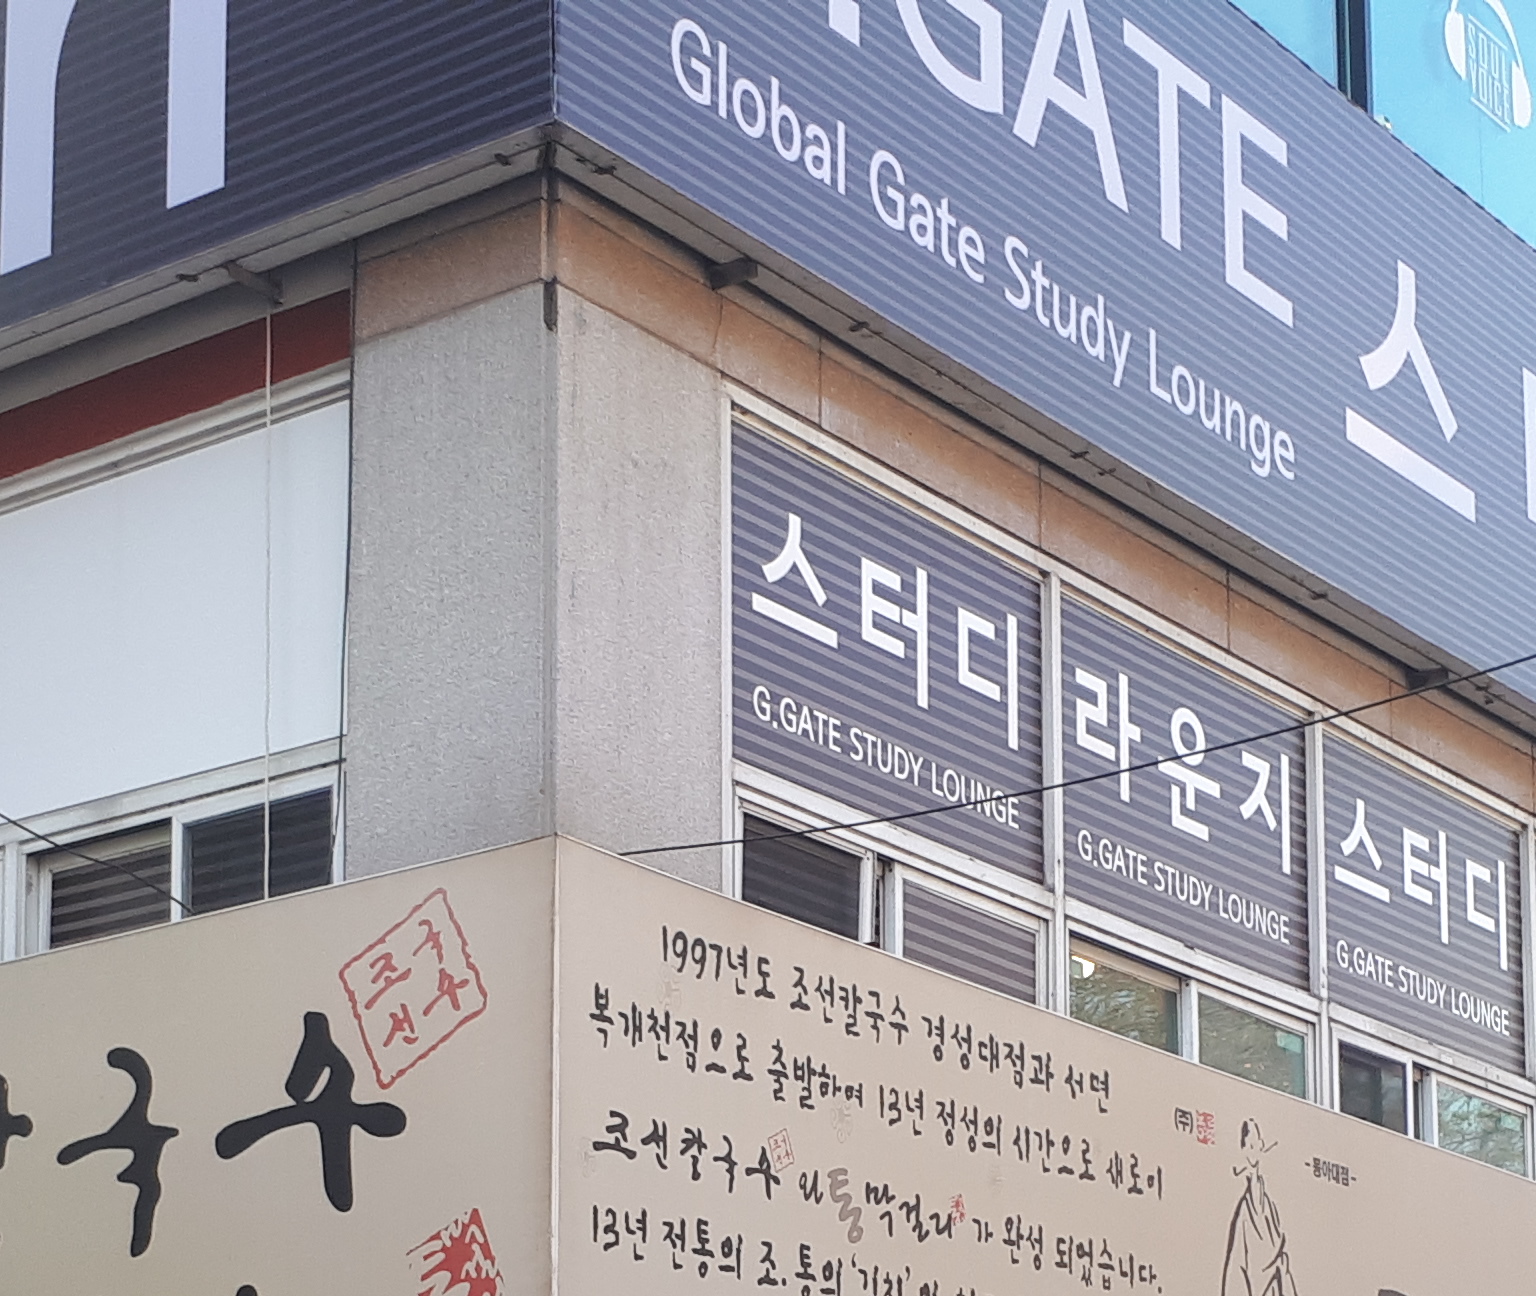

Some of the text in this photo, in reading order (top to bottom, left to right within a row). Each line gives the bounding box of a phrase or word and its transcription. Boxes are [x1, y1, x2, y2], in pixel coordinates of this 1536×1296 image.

[1467, 22, 1509, 89] SOUL
[1469, 60, 1511, 125] VOICE
[671, 17, 1298, 482] Global Gate Study Lounge
[751, 512, 1020, 751] 스터디
[1075, 667, 1292, 875] 라운지
[1334, 798, 1508, 972] 스터디
[753, 685, 1020, 830] G.GATE STUDY LOUNGE
[1077, 829, 1290, 945] G.GATE STUDY LOUNGE
[662, 925, 1110, 1113] 1997년도 조선칼국수 경성대점과 서면
[1336, 939, 1510, 1036] G.GATE STUDY LOUNGE
[589, 982, 754, 1082] 복개천점으로
[879, 1084, 924, 1136] 13년
[936, 1098, 1002, 1156] 정성의
[1013, 1126, 1096, 1181] 시간으로
[1105, 1150, 1162, 1200] 새로이
[592, 1110, 781, 1200] 조선칼국수
[971, 1217, 994, 1243] 가
[1002, 1214, 1044, 1271] 완성
[1054, 1235, 1164, 1294] 되었습니다.
[592, 1204, 647, 1262] 13년
[662, 1217, 744, 1280] 전통의
